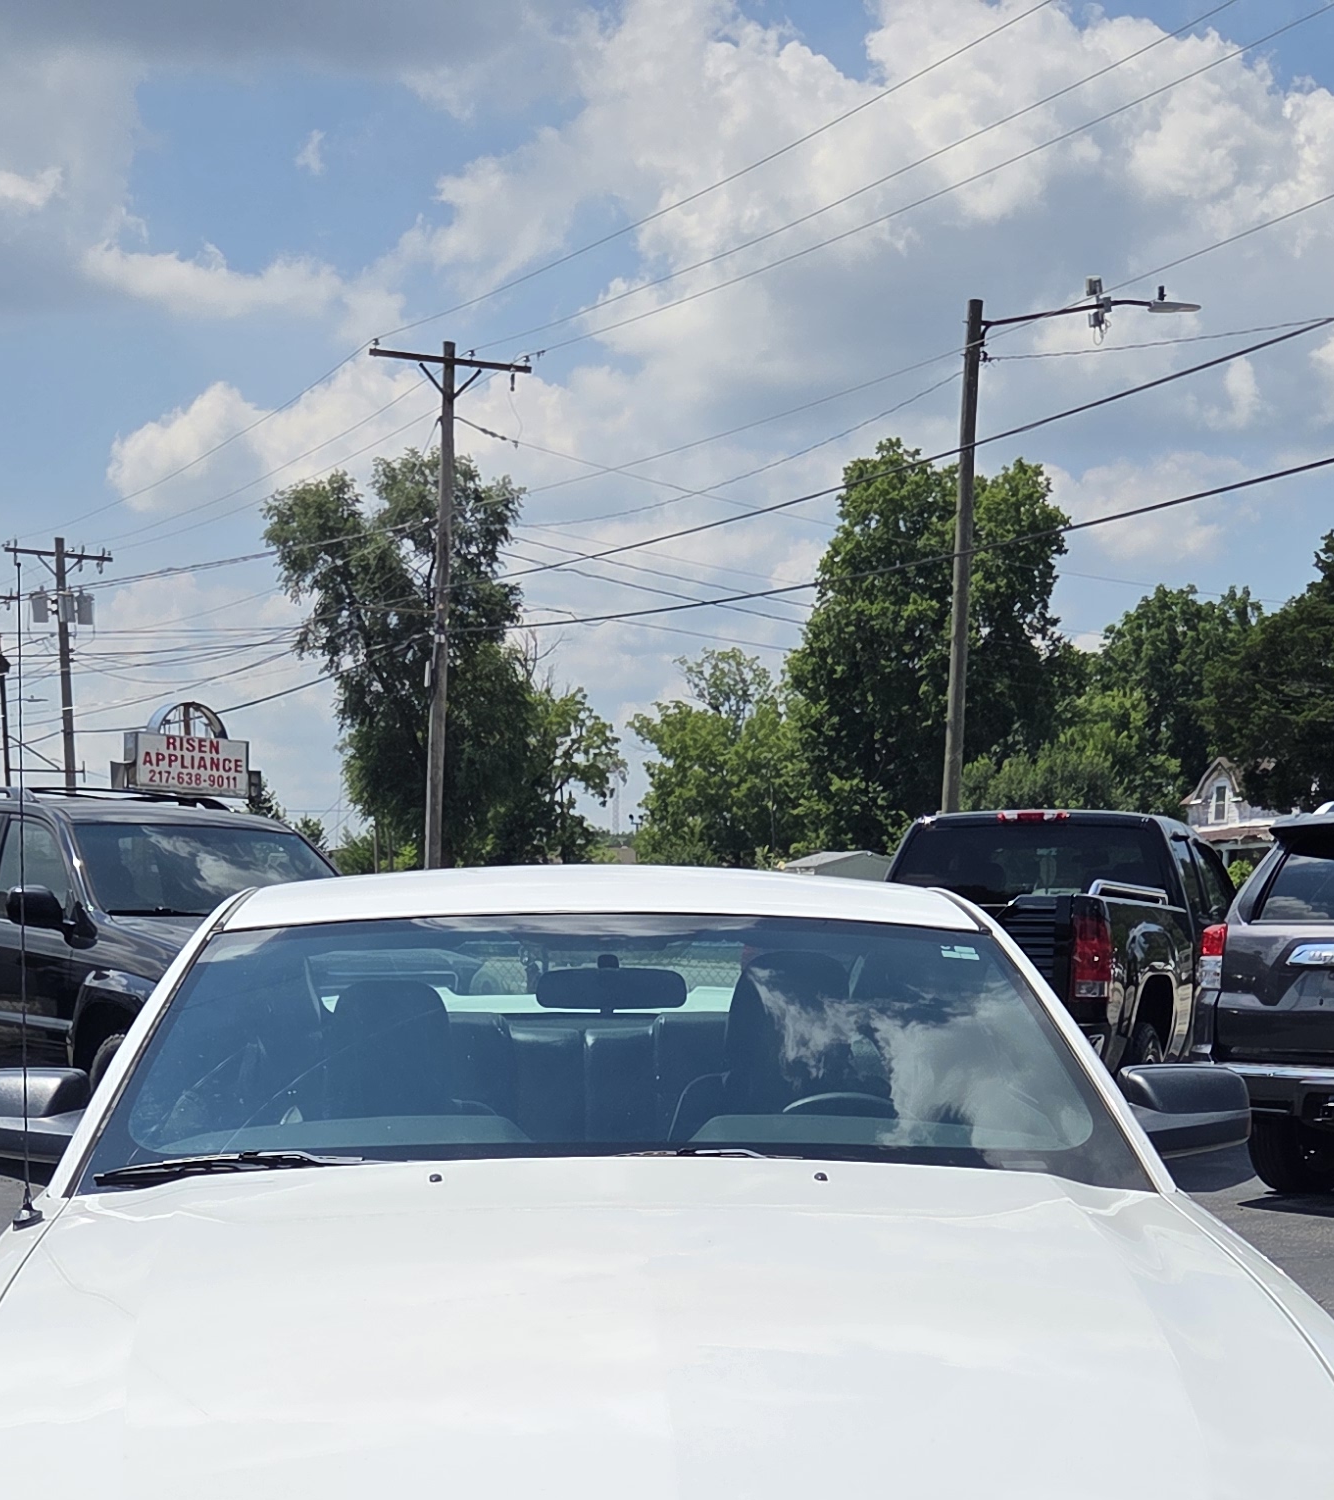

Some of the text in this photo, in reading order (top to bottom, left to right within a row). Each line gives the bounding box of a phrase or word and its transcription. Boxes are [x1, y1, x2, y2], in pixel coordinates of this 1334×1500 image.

[165, 735, 220, 755] RISEN
[142, 751, 244, 774] APPLIANCE
[148, 769, 238, 789] 217-638-9011
